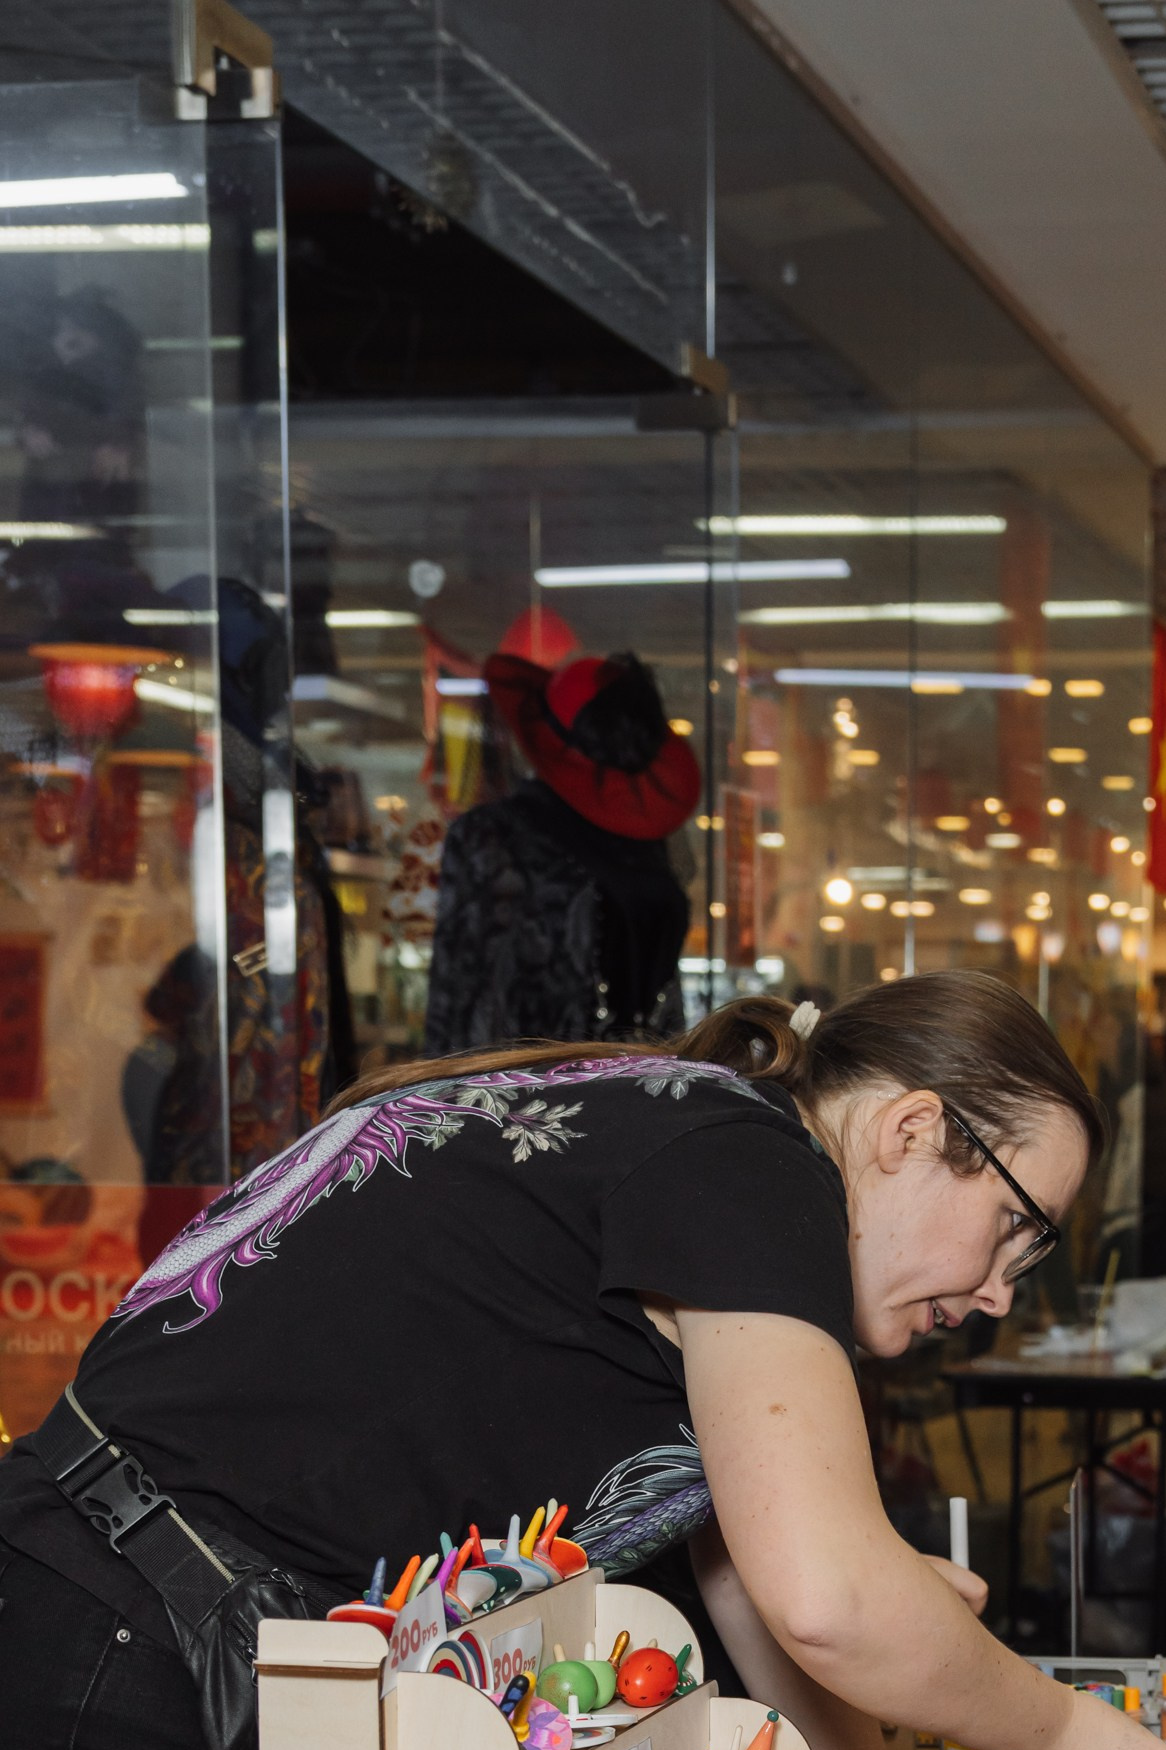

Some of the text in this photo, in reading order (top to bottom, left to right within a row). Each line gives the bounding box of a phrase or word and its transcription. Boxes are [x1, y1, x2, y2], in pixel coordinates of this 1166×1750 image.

[390, 1618, 439, 1670] 200 РУБ
[493, 1647, 523, 1691] 300
